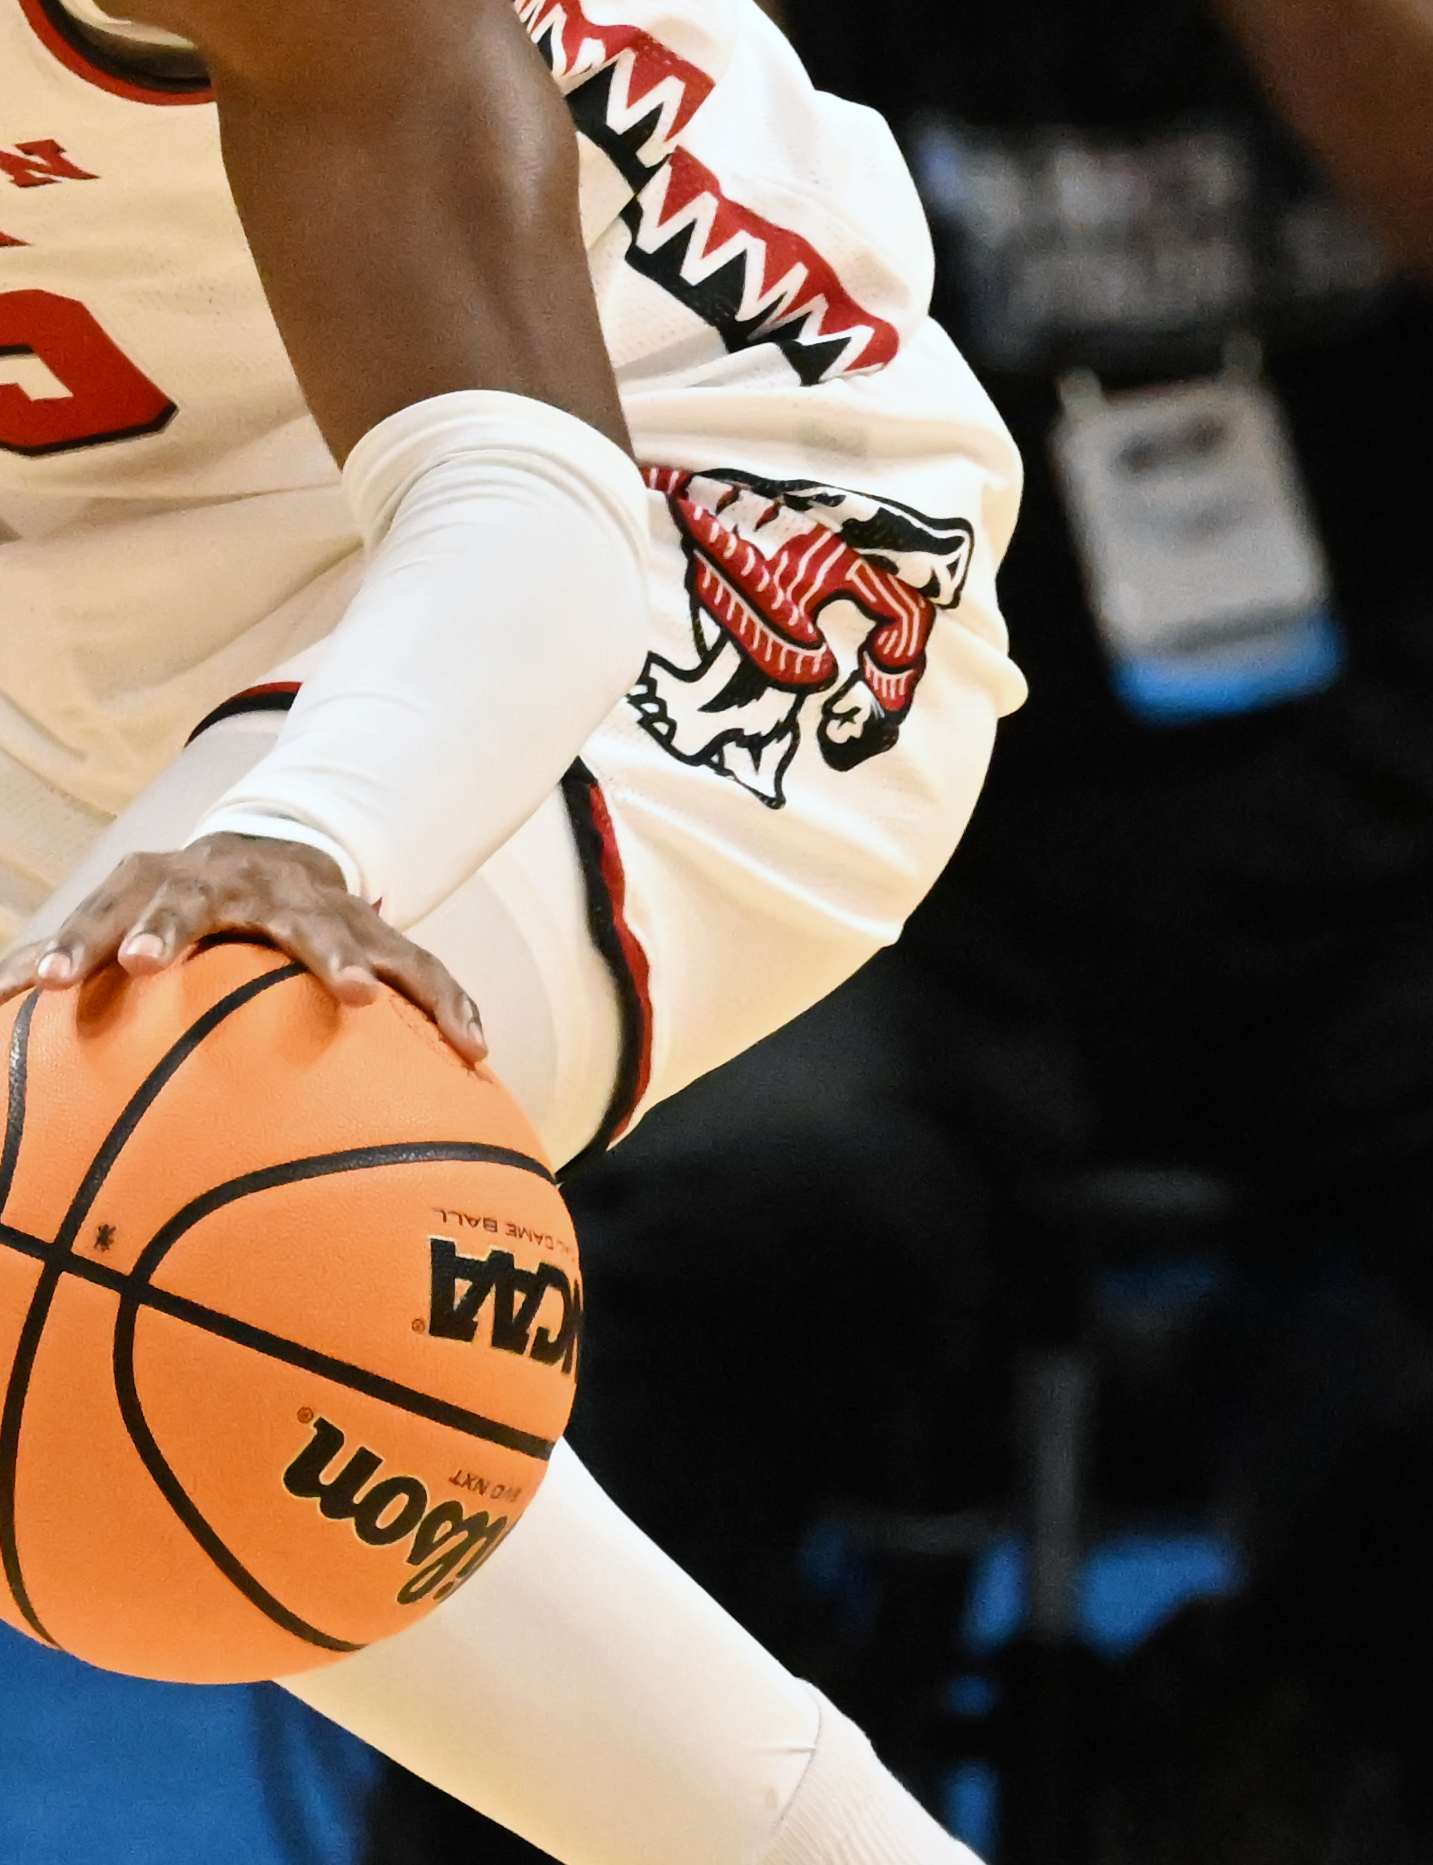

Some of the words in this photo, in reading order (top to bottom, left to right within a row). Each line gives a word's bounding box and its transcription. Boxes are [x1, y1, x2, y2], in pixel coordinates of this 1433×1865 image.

[431, 1206, 499, 1234] BALL
[447, 1469, 491, 1496] NXT
[282, 1415, 509, 1606] ilson
